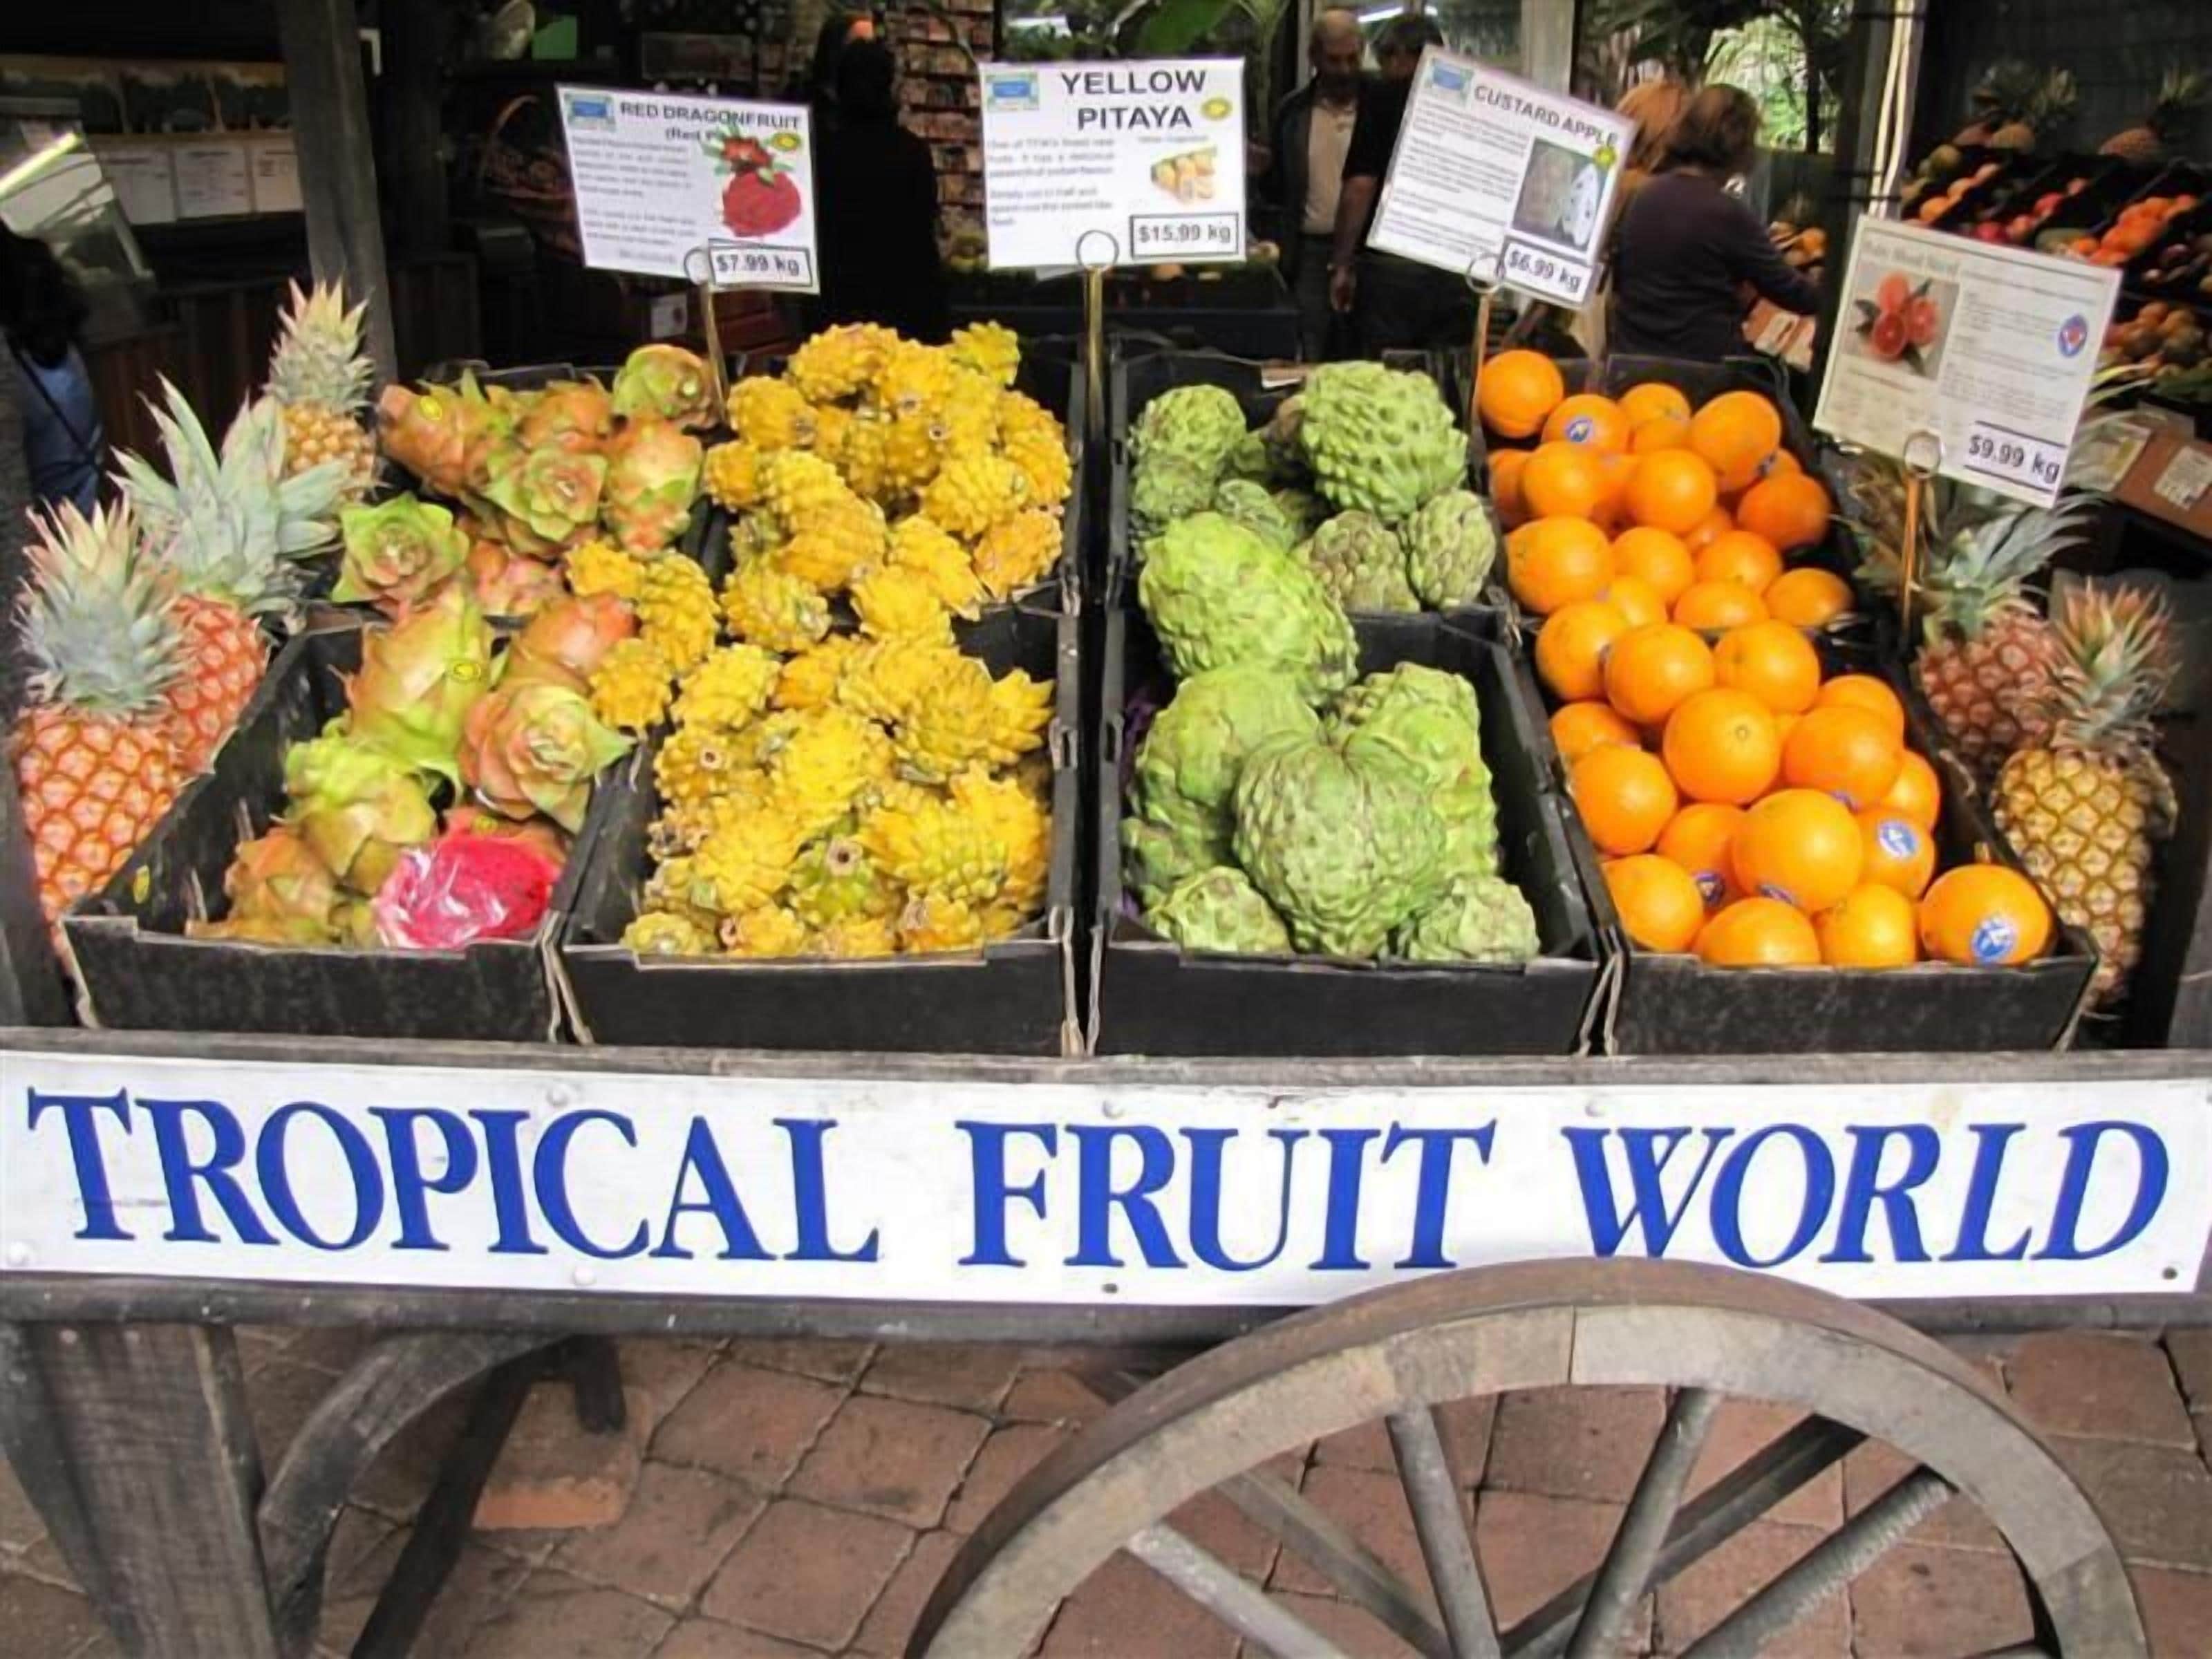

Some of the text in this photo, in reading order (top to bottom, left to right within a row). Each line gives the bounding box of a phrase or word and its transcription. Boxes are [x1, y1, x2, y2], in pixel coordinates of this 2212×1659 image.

[1061, 70, 1207, 95] YELLOW
[620, 102, 801, 129] RED DRAGONFRUIT
[1077, 105, 1193, 131] PITAYA
[1474, 85, 1559, 127] CUSTARD
[1562, 116, 1618, 147] APPLE
[1139, 223, 1231, 244] $15.99 kg
[715, 253, 800, 276] $7.99 kg
[1508, 249, 1583, 294] $6.99 kg
[1969, 434, 2061, 484] $9.99 kg
[27, 1085, 2170, 1272] TROPICAL FRUIT WORLD
